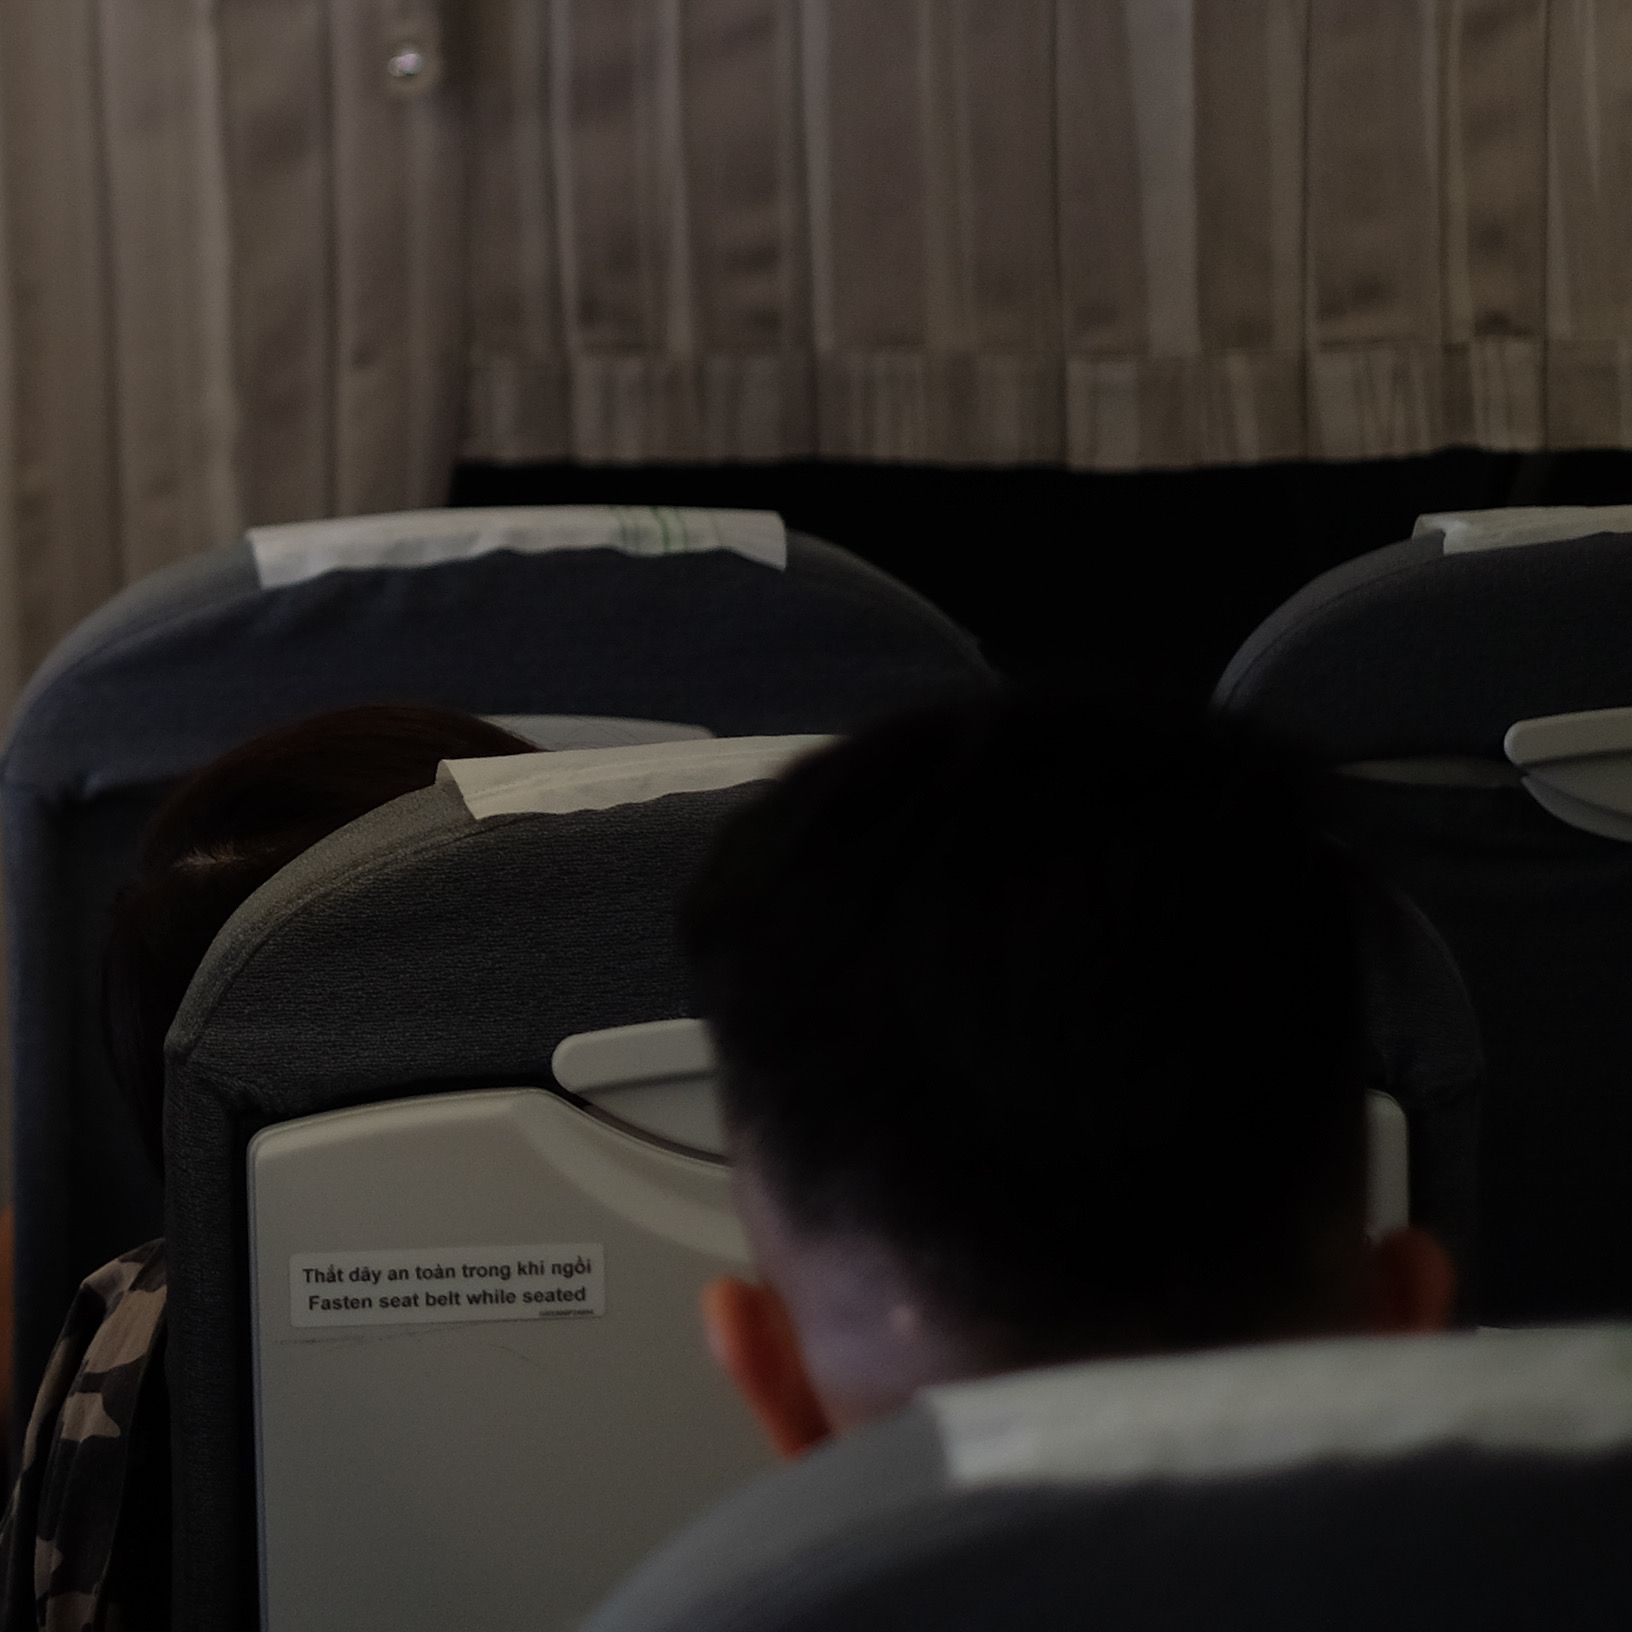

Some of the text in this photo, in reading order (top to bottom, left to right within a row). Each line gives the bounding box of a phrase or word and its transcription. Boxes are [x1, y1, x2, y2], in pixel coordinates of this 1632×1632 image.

[388, 1268, 409, 1281] an
[462, 1264, 511, 1280] trong
[517, 1260, 544, 1276] khi
[309, 1286, 586, 1311] Fasten seat belt while seated
